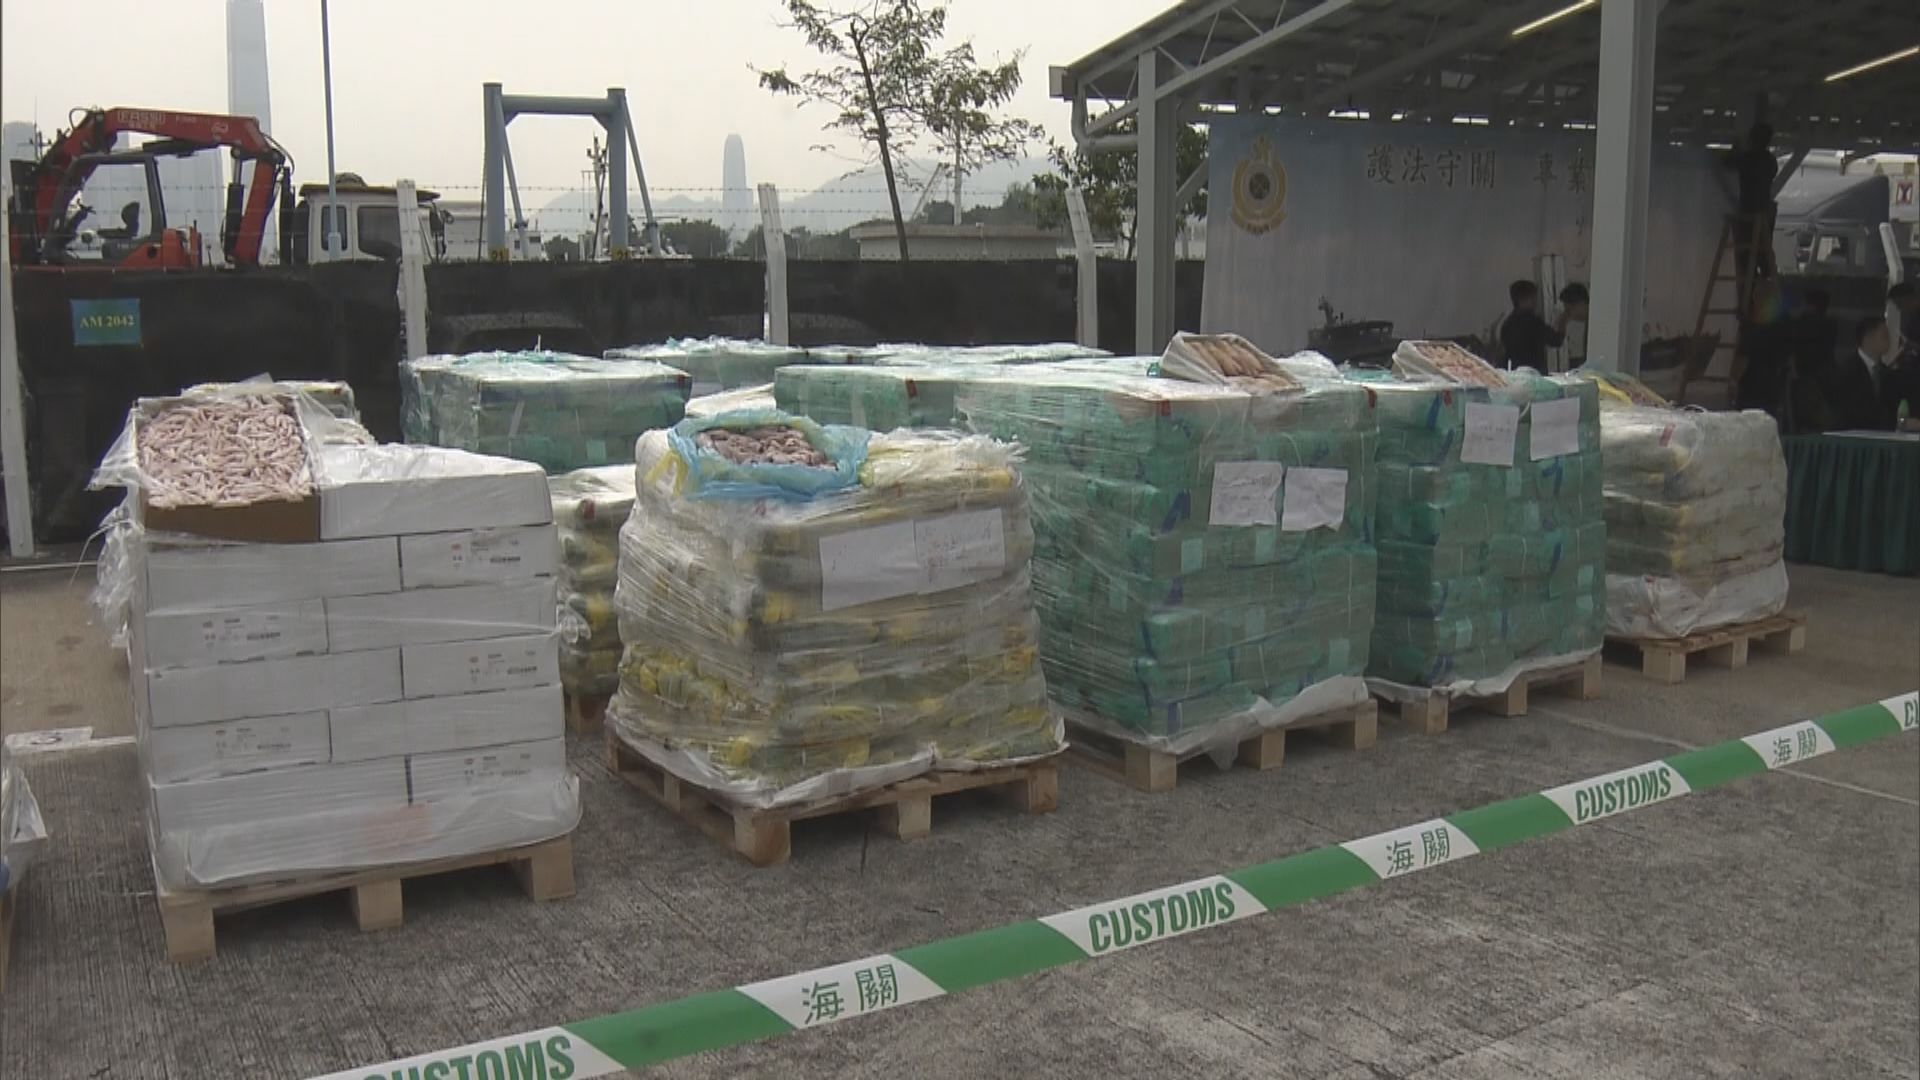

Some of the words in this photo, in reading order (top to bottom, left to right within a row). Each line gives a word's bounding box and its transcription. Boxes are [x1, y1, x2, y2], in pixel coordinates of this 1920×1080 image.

[1367, 145, 1497, 190] 護法守關
[80, 315, 102, 328] AM
[106, 314, 135, 328] 2042
[1772, 727, 1817, 766] 海關
[1575, 766, 1671, 821] CUSTOMS
[1386, 827, 1450, 876] 海關
[1089, 881, 1236, 953] CUSTOMS
[801, 963, 899, 1025] 海關
[362, 1035, 576, 1080] TOMS
